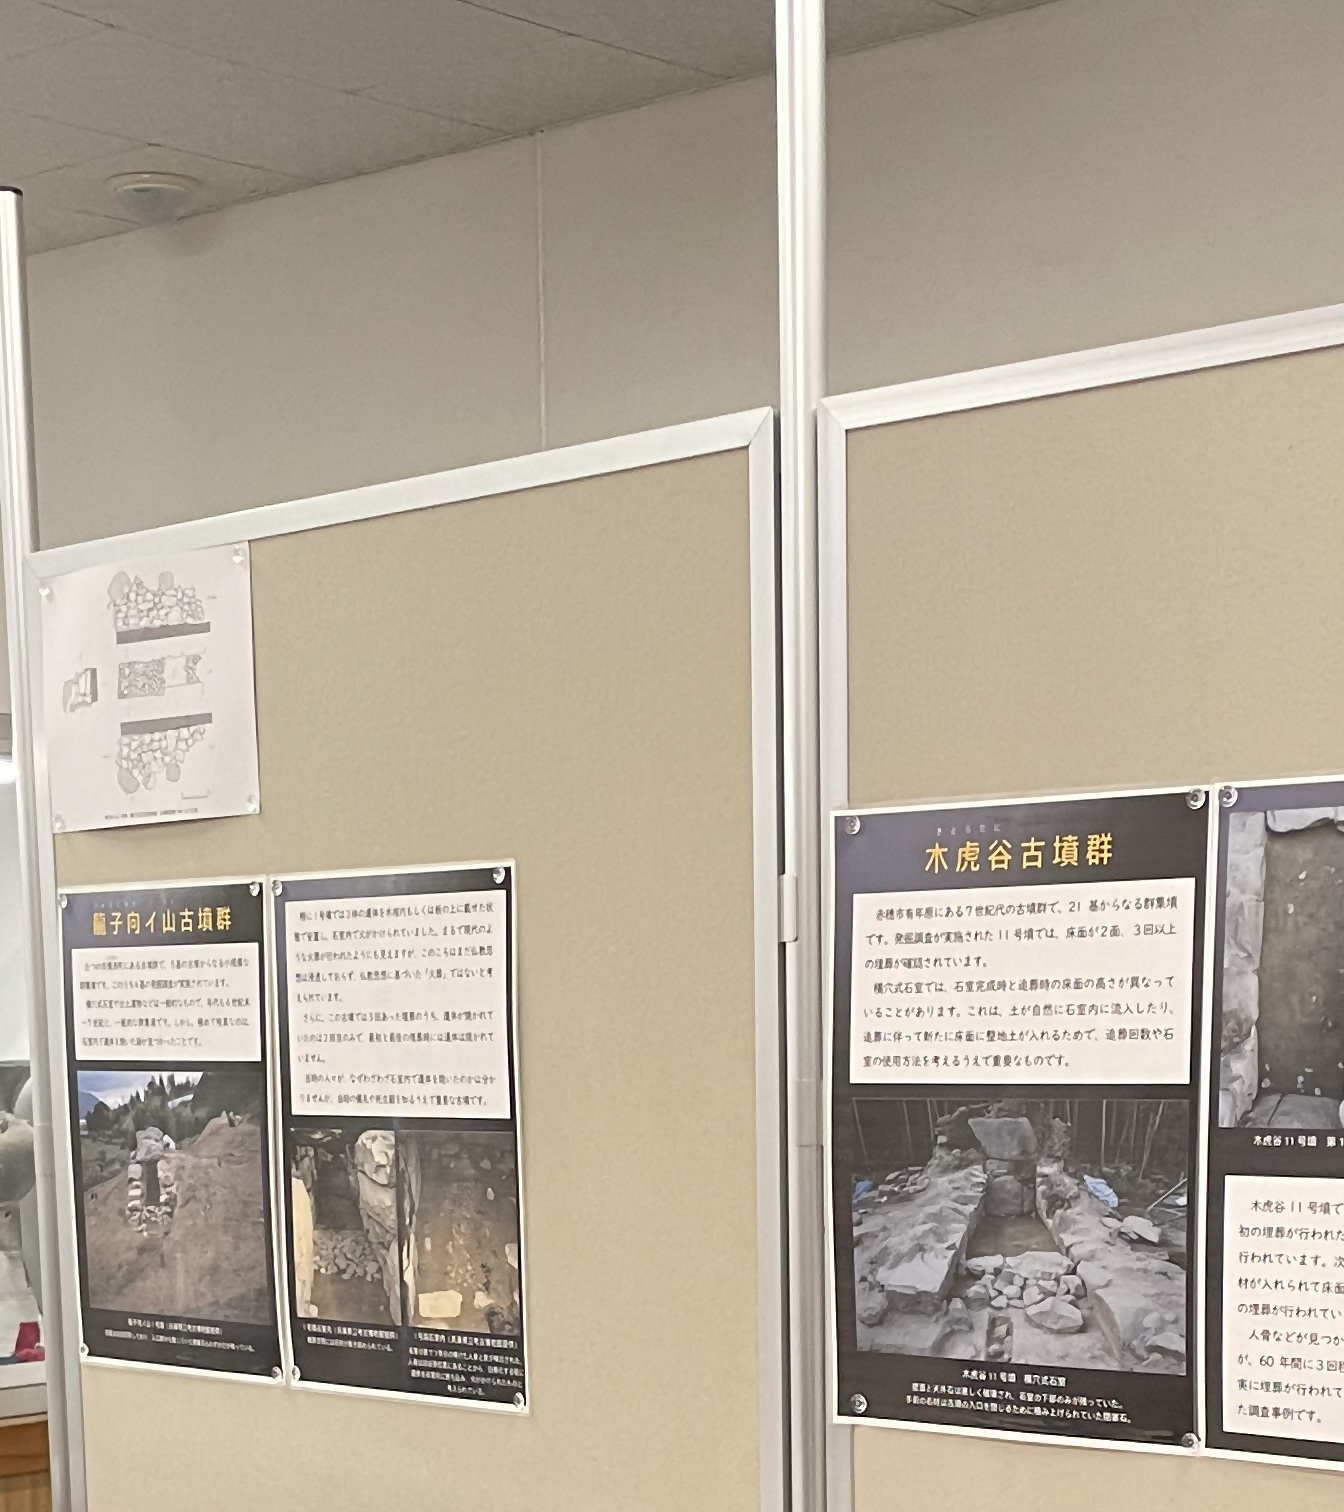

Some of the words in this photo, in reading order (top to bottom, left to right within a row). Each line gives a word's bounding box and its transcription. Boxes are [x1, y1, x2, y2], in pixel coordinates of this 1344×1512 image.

[925, 833, 1114, 873] 木虎谷古墳群
